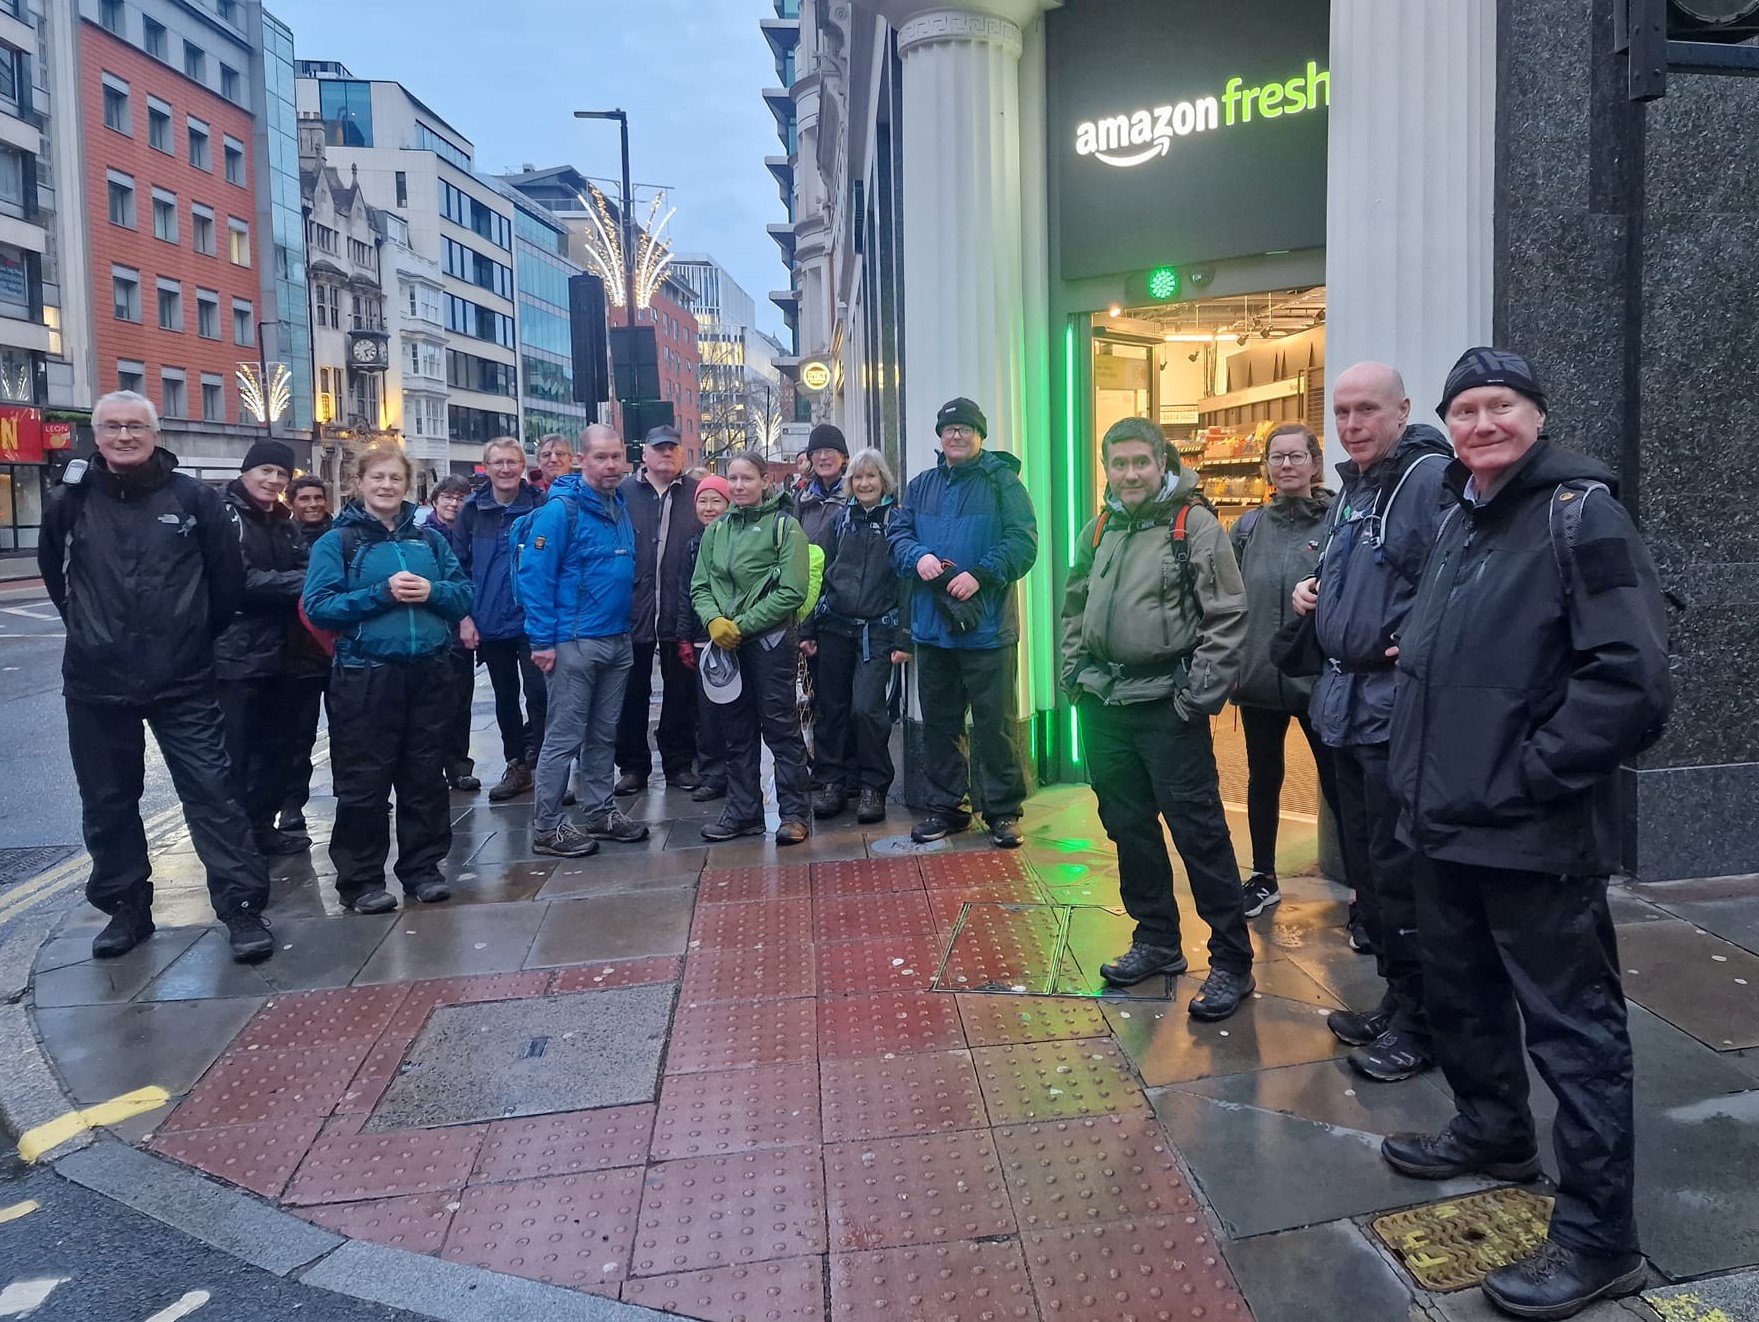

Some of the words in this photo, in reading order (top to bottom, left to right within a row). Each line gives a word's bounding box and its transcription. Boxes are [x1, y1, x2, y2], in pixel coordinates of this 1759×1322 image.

[1076, 96, 1218, 155] amazon
[1221, 61, 1330, 127] fresh
[45, 425, 68, 433] LEON
